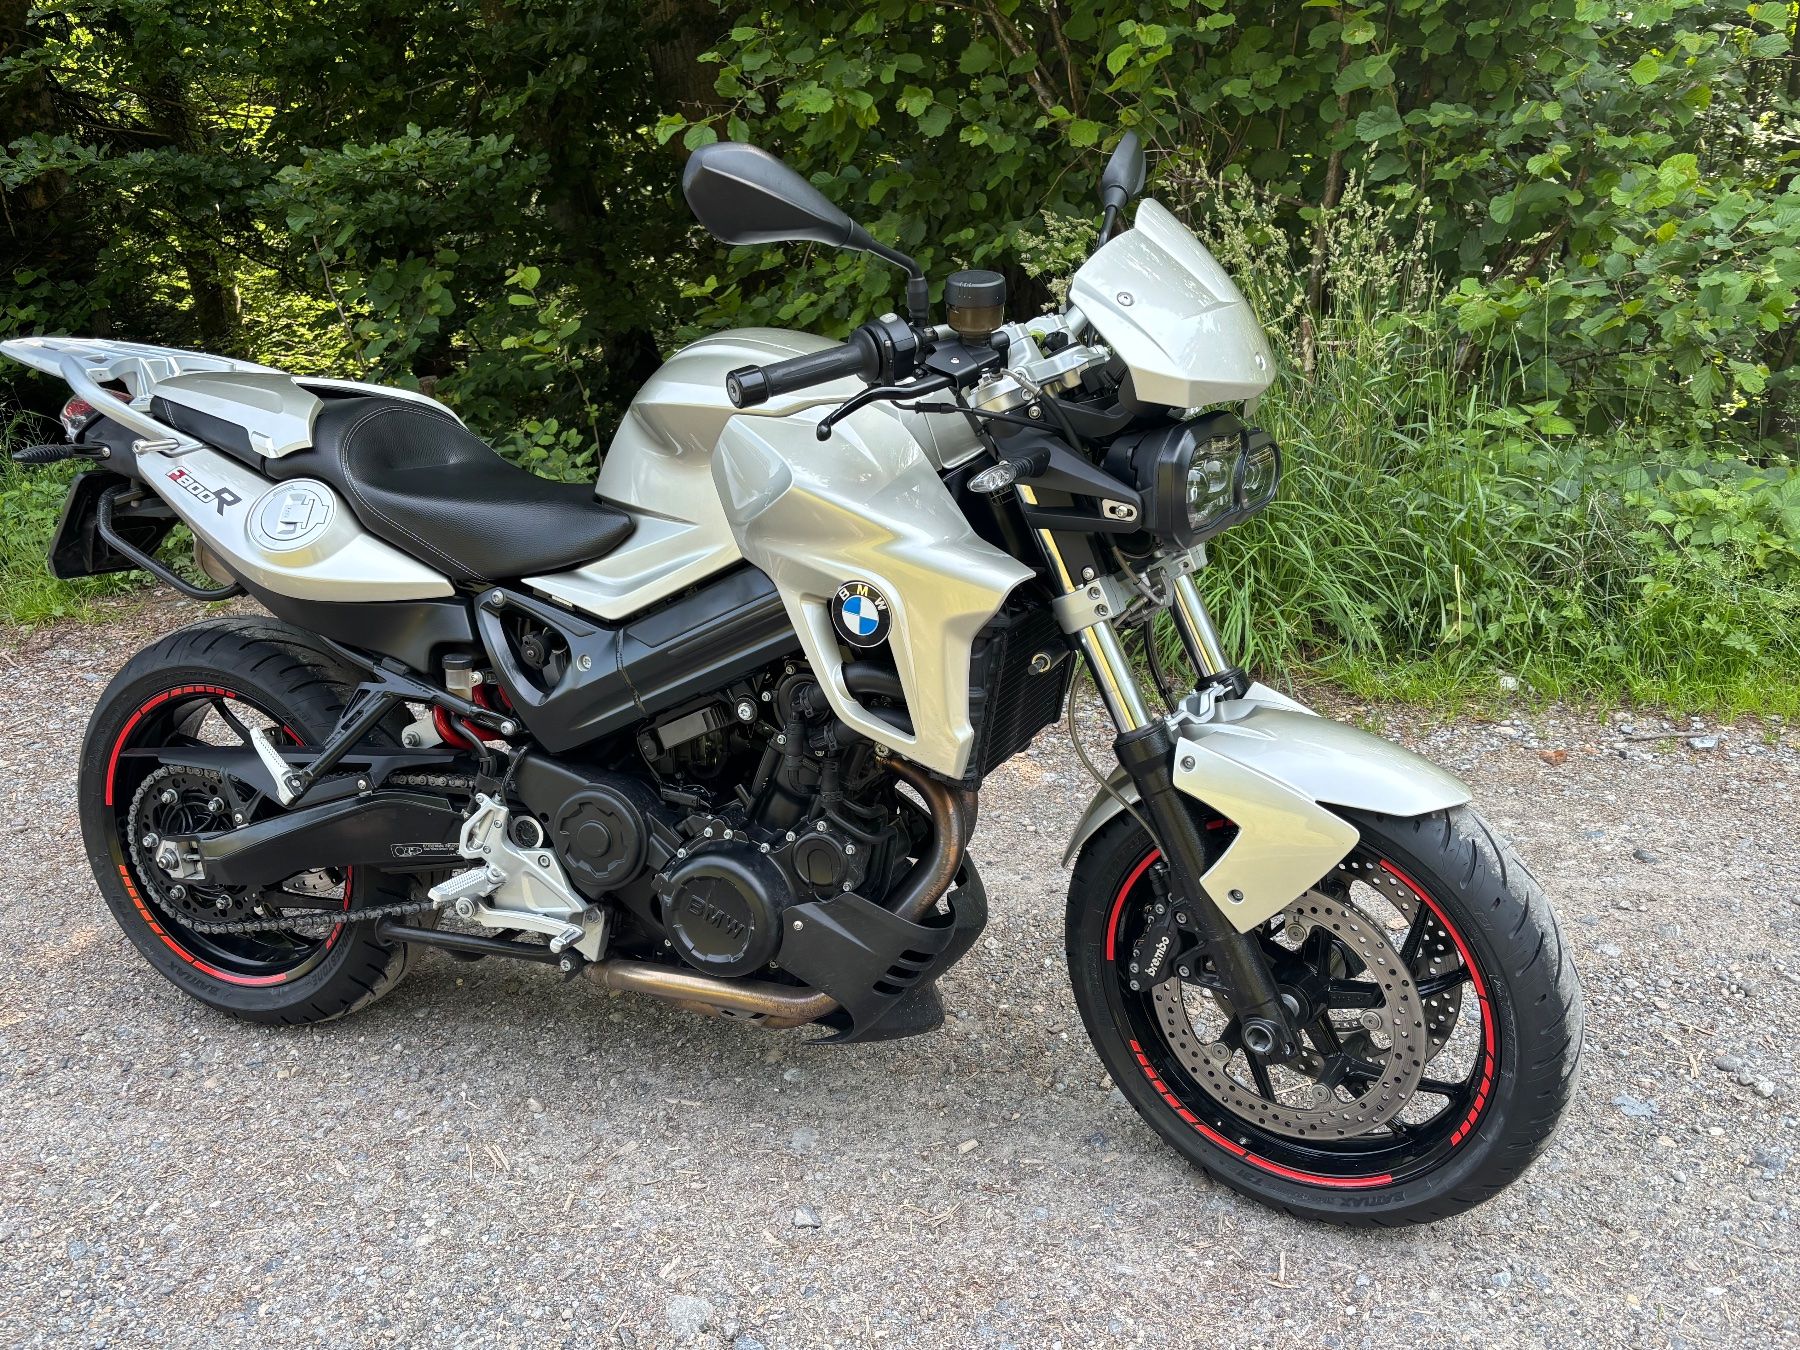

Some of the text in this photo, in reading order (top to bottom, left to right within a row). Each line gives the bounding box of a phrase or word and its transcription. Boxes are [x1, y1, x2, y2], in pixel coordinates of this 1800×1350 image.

[838, 584, 888, 611] BMW
[689, 894, 746, 939] BMW
[1145, 936, 1170, 978] brembo
